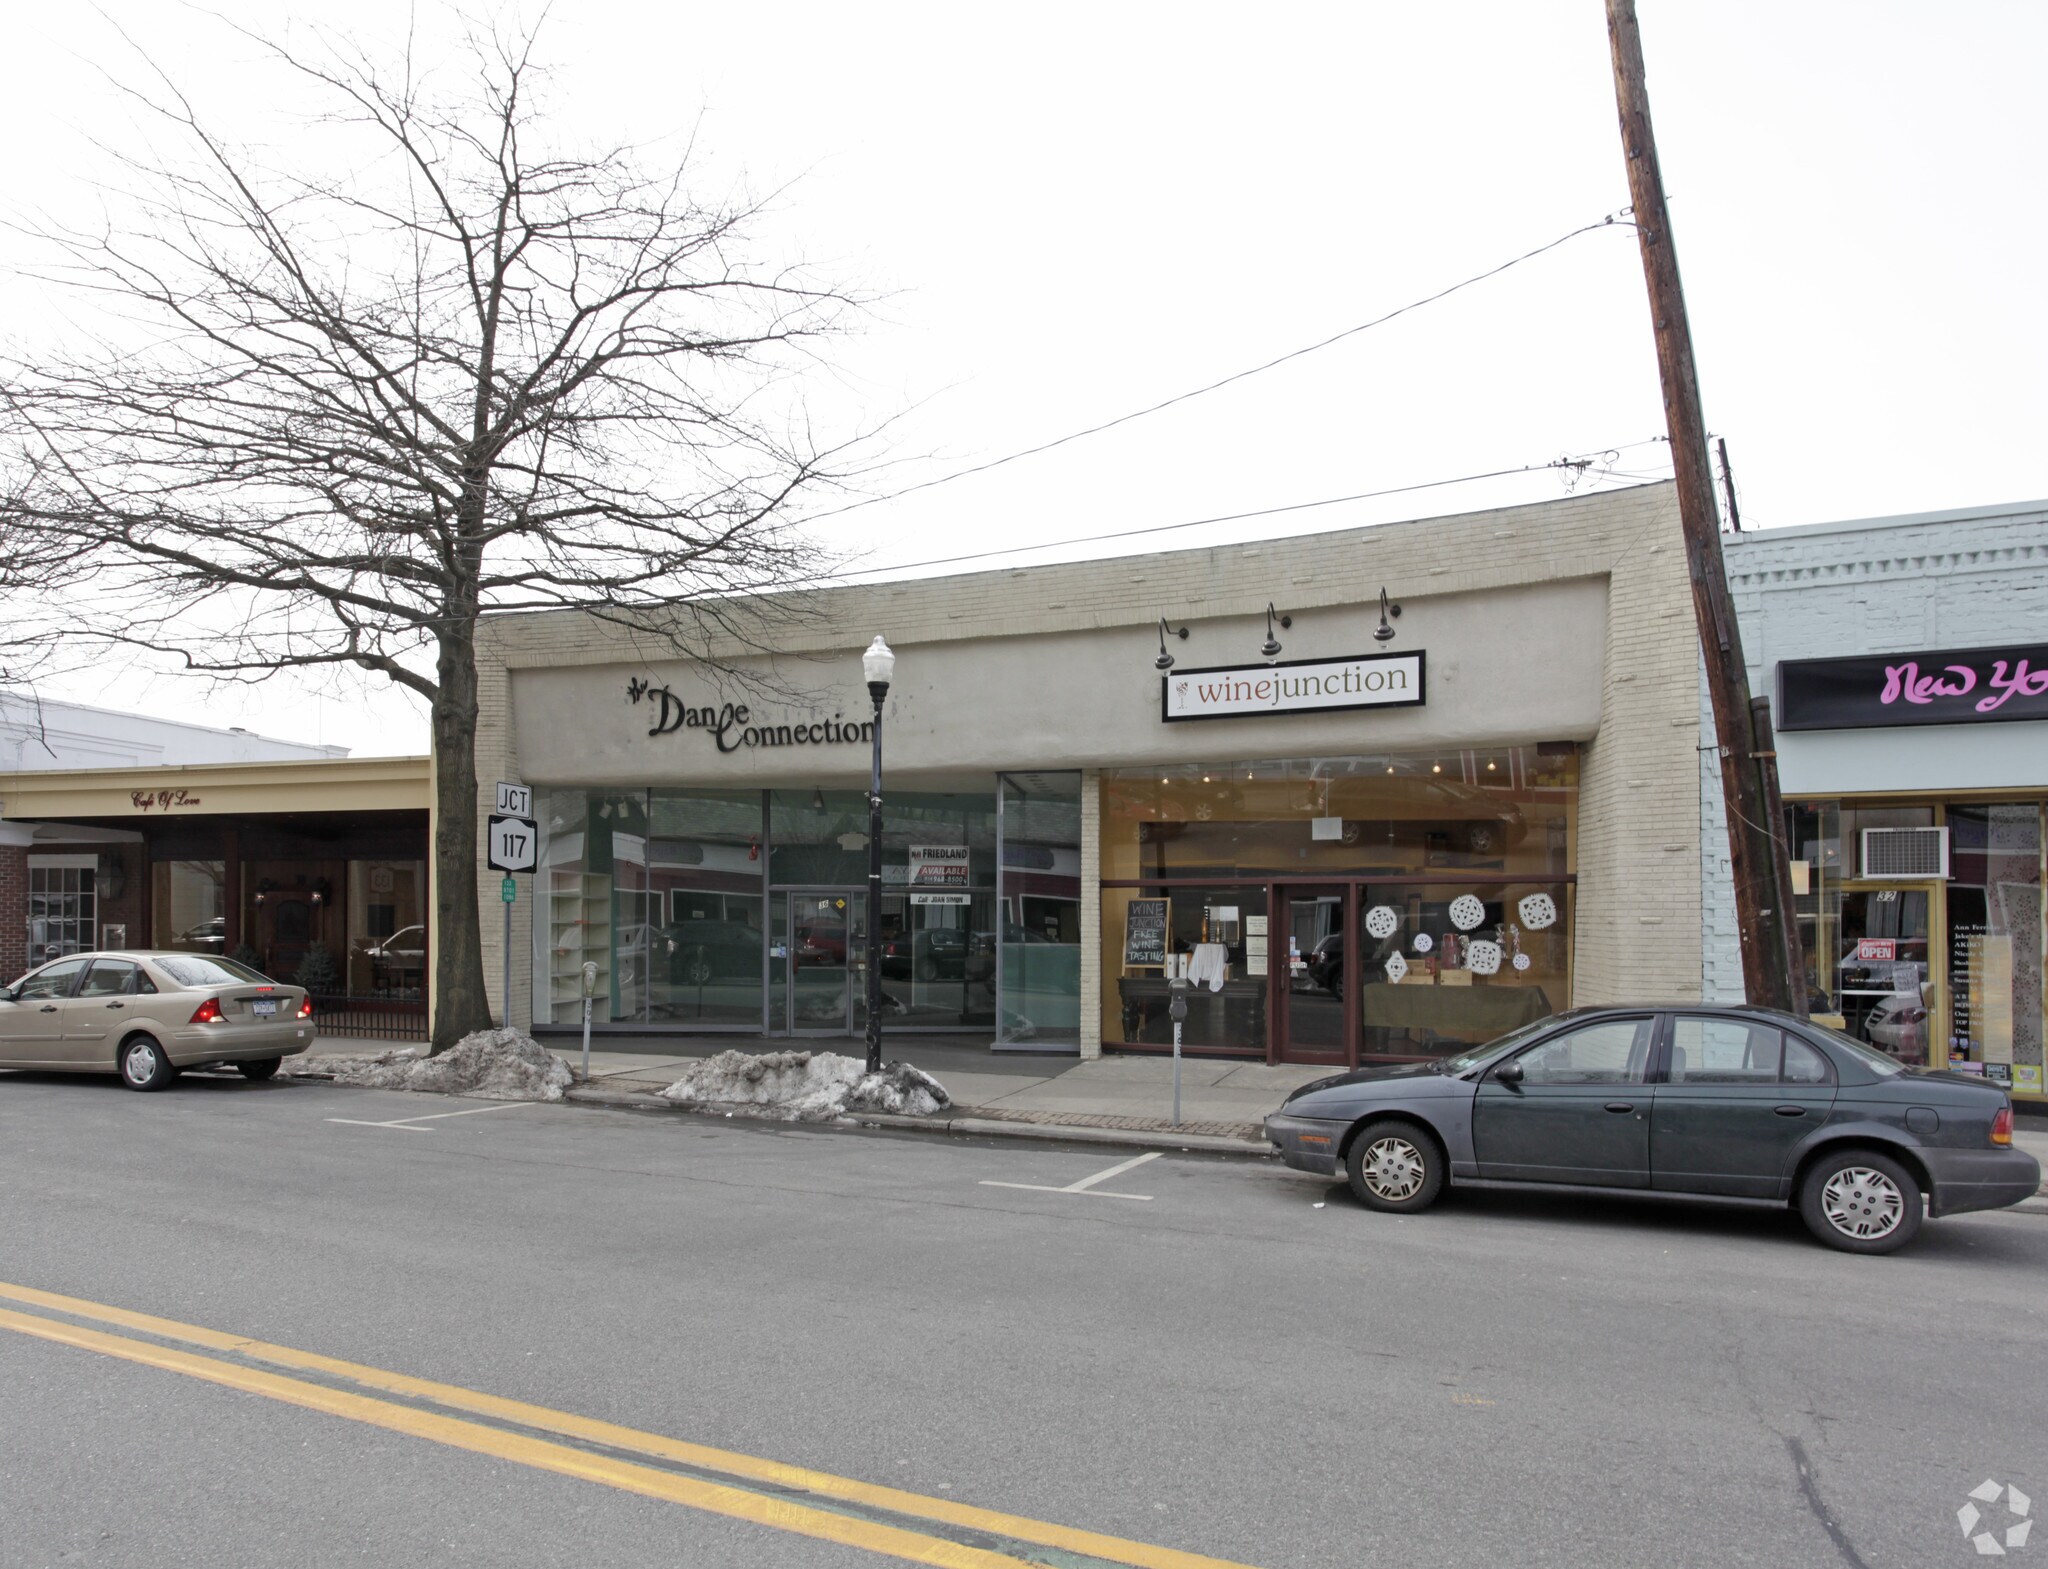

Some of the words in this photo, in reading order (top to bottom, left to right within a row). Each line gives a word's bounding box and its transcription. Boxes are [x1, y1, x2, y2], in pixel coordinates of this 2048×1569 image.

[1197, 665, 1408, 706] winejunction
[1880, 661, 1976, 704] New
[648, 684, 750, 737] Dance
[707, 702, 876, 752] Connection
[157, 790, 174, 811] Of
[174, 789, 201, 806] Love
[499, 788, 527, 813] JCT
[503, 833, 527, 858] 117
[922, 848, 967, 859] FRIEDLAND
[921, 866, 967, 875] AVAILABLE
[1878, 892, 1895, 900] 32
[1132, 903, 1164, 916] WINE
[1129, 917, 1166, 928] JUNCTION
[1133, 929, 1160, 939] FREE
[1131, 940, 1160, 949] WINE
[1128, 951, 1164, 961] TASTING
[1861, 947, 1892, 959] OPEN
